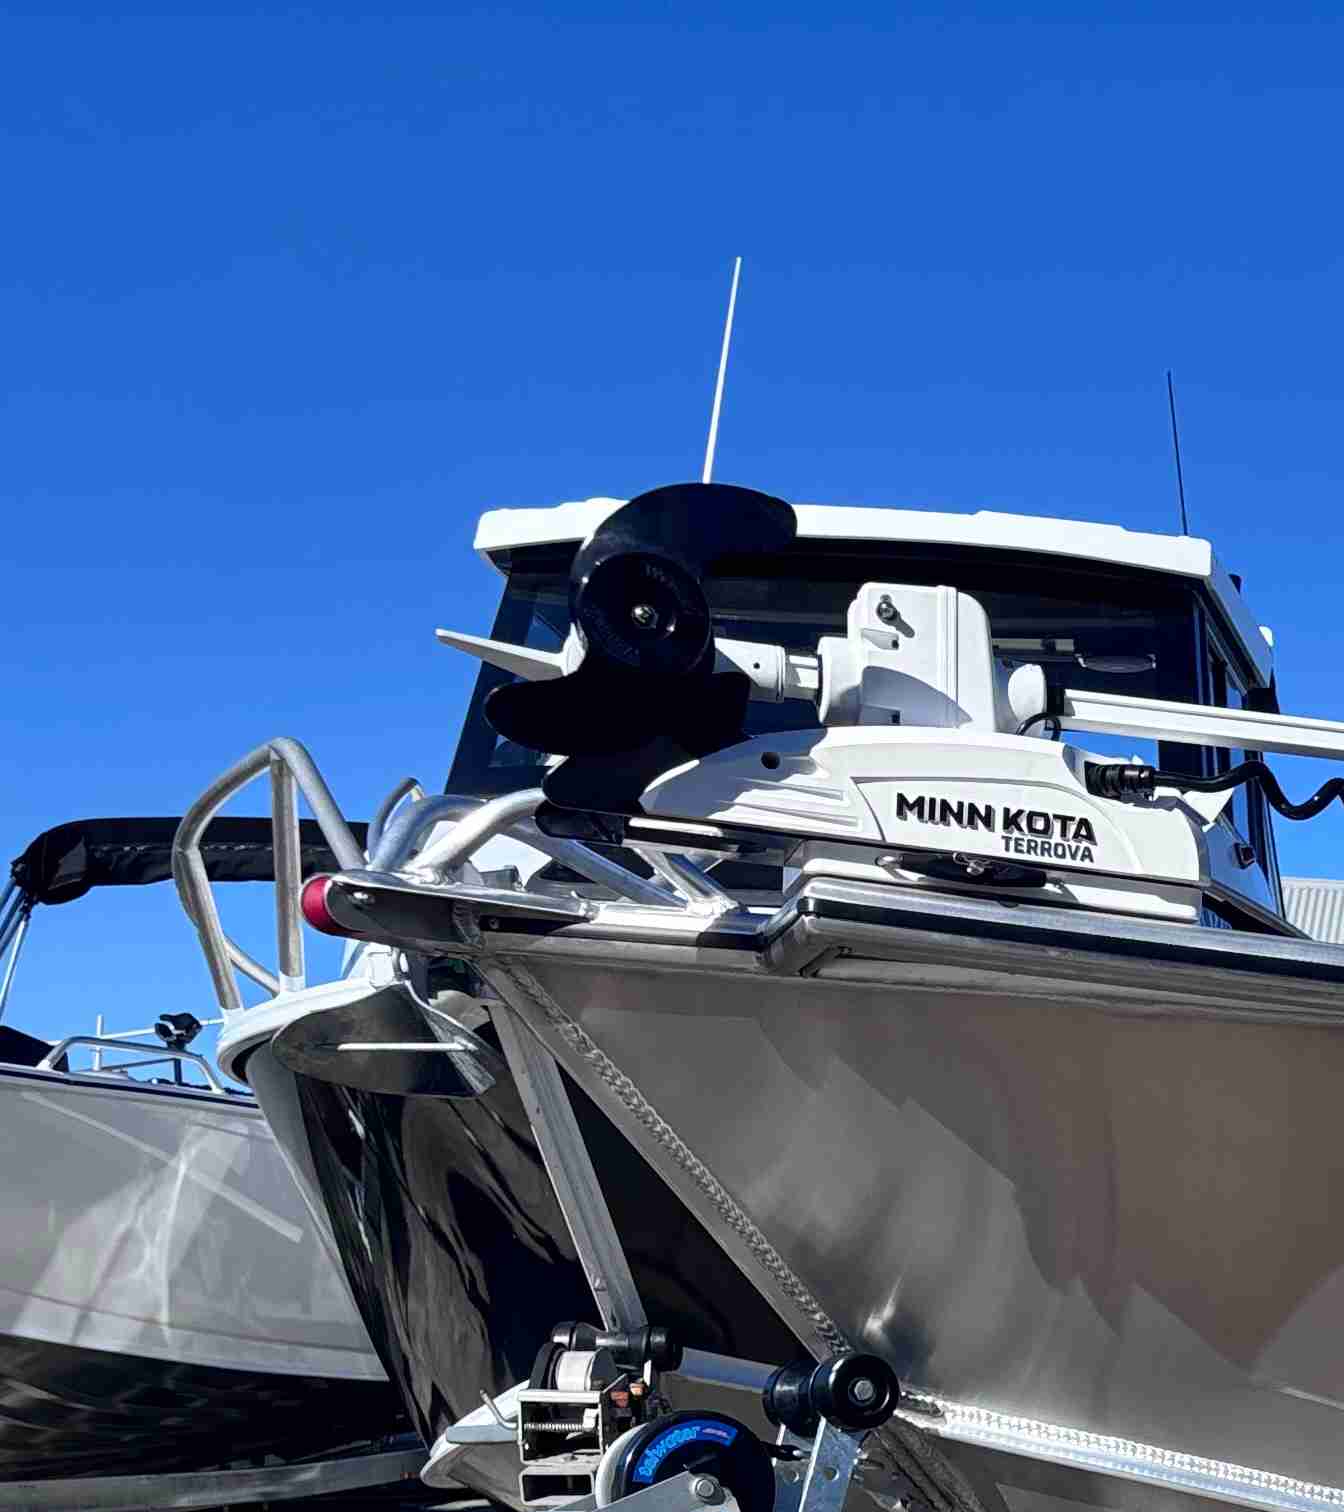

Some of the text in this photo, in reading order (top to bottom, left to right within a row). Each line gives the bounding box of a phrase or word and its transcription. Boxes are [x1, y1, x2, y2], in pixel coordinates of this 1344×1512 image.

[896, 792, 1098, 847] MINN KOTA
[1001, 835, 1094, 863] TERROVA
